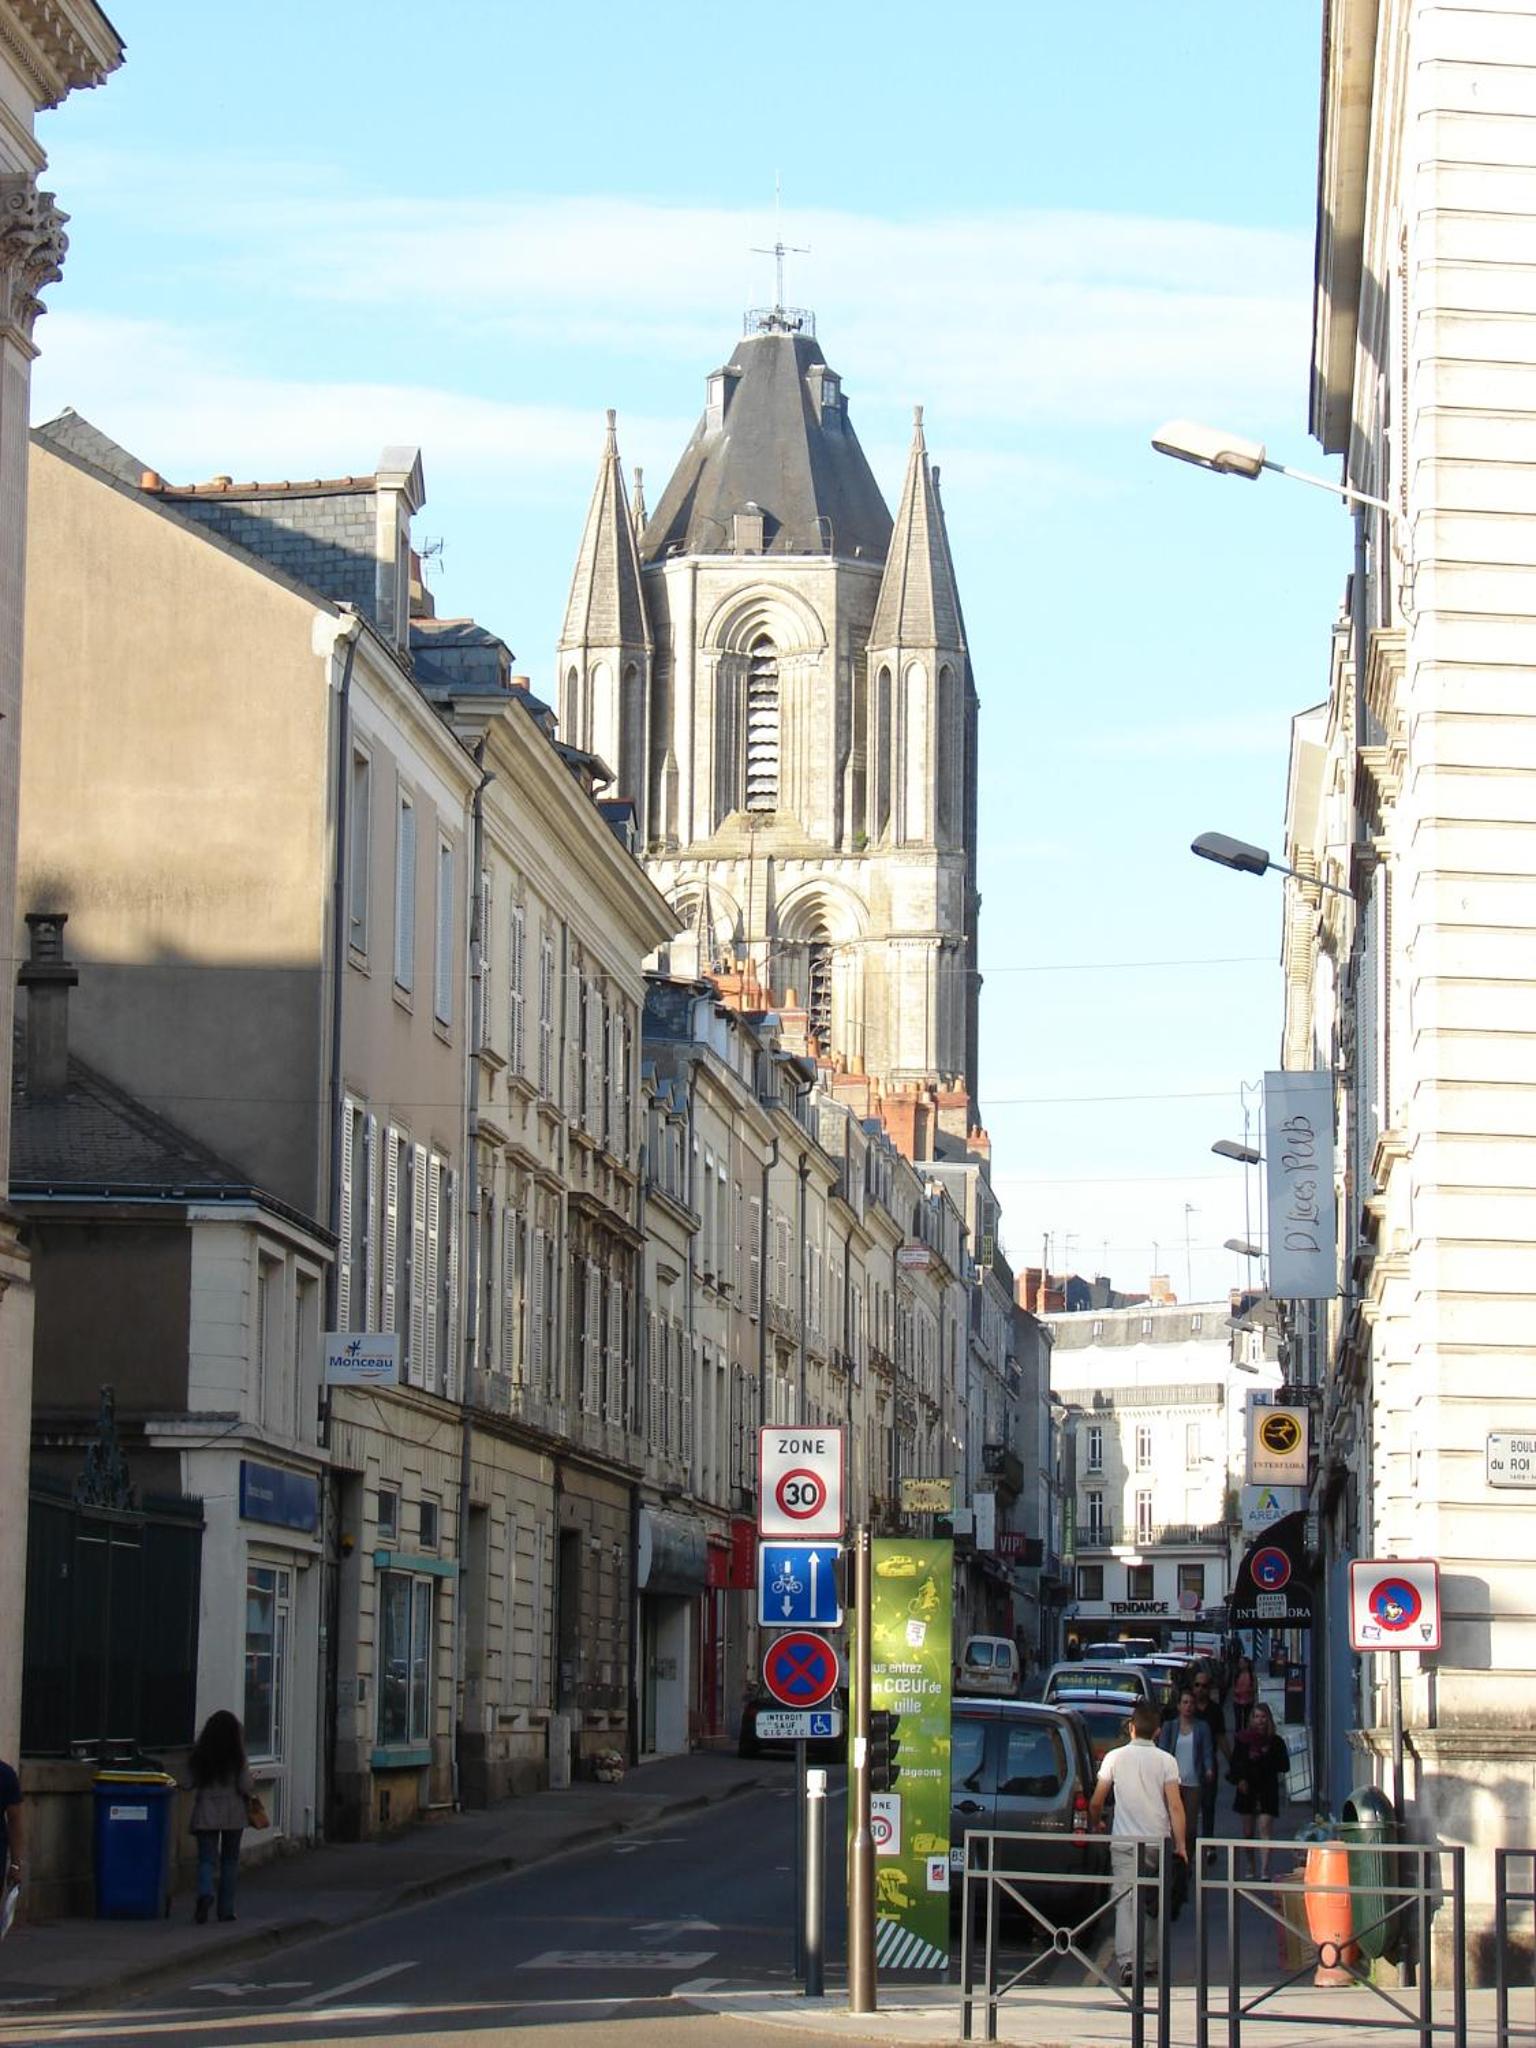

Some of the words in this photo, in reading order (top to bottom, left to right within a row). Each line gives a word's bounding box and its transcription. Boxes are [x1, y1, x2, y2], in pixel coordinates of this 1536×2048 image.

[329, 1356, 393, 1367] Monceau
[778, 1439, 826, 1454] ZONE
[1253, 1461, 1305, 1470] INTERFLORA
[1490, 1459, 1504, 1470] du
[1510, 1458, 1530, 1471] ROI
[785, 1482, 817, 1506] 30
[1110, 1602, 1169, 1613] TENDANCE
[888, 1662, 923, 1674] entrez
[929, 1682, 942, 1693] de
[894, 1698, 922, 1713] ville
[872, 1801, 891, 1810] ONE
